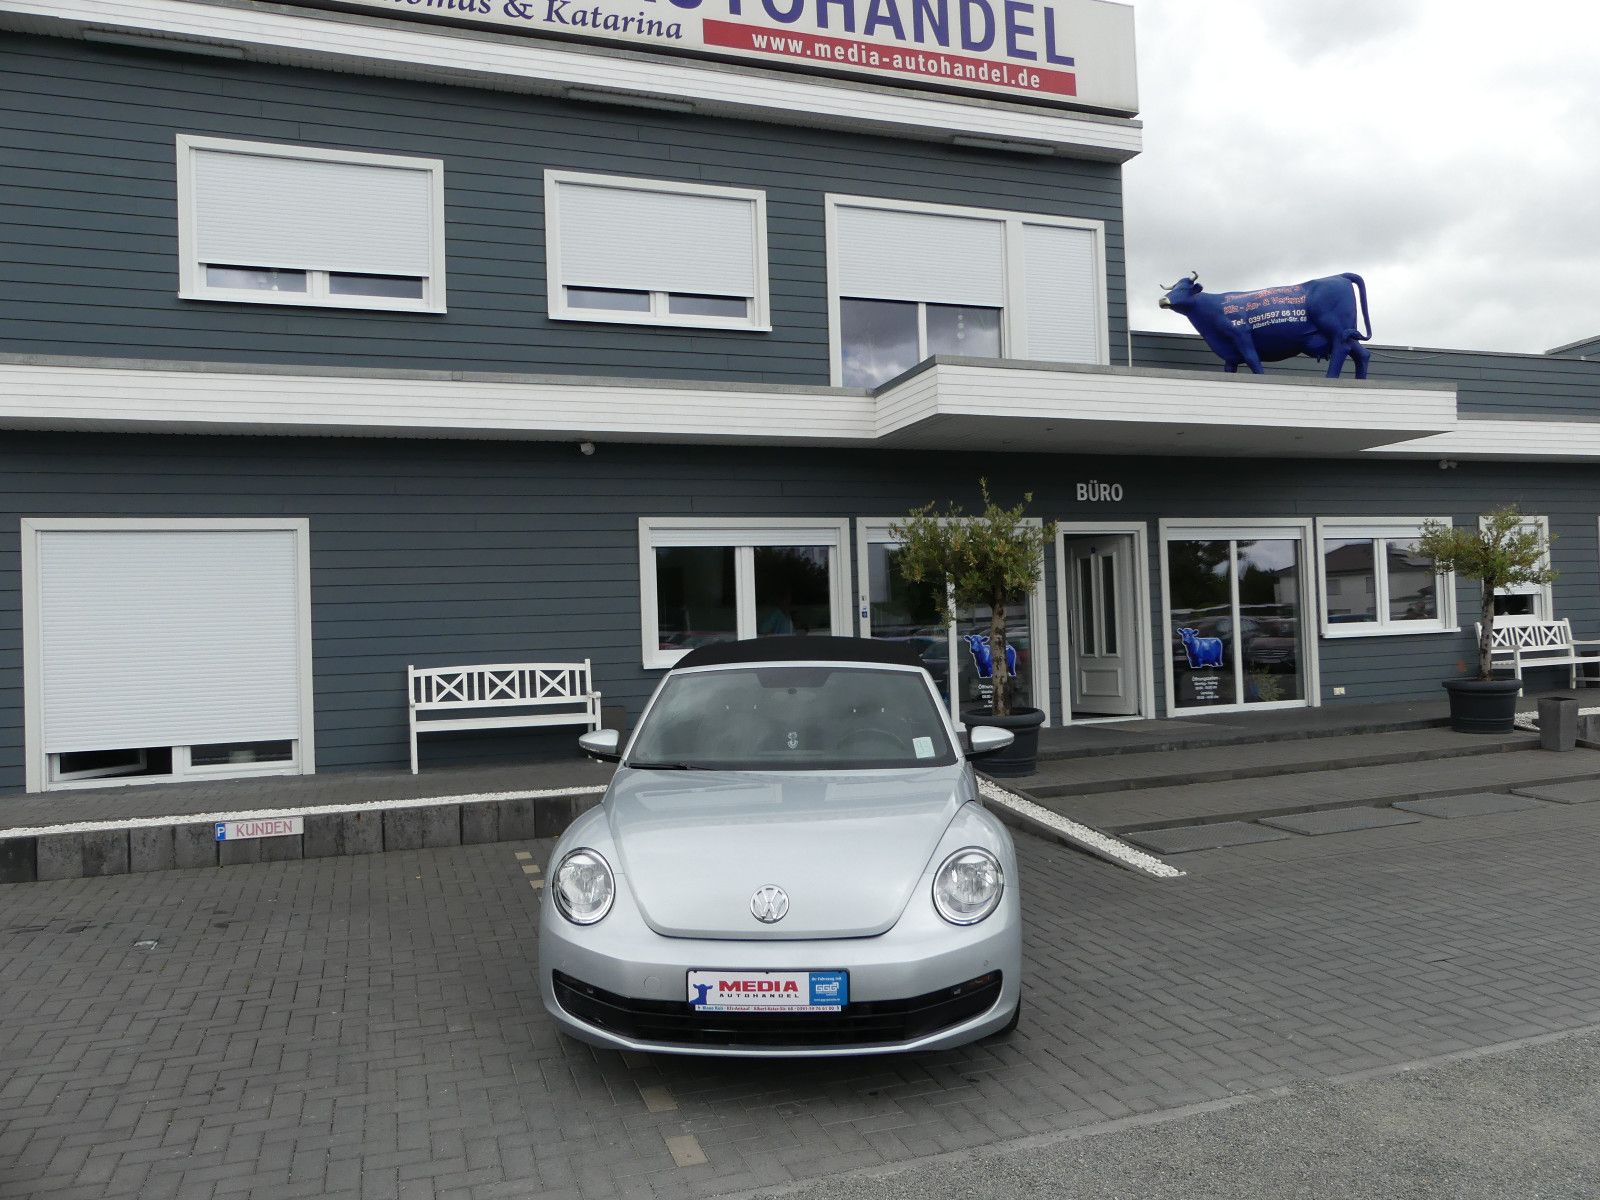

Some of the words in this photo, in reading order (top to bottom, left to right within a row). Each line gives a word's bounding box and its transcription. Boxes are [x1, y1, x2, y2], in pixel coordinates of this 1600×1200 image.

[503, 0, 534, 20] &
[543, 0, 682, 39] Katarina
[644, 0, 1075, 66] HANDEL
[752, 32, 1040, 89] www.media-autohandel.de
[1231, 318, 1246, 327] Tel.
[1292, 309, 1306, 317] 100
[1076, 480, 1123, 502] BÜRO
[217, 826, 225, 837] P
[236, 820, 293, 837] KUNDEN
[718, 980, 799, 992] MEDIA
